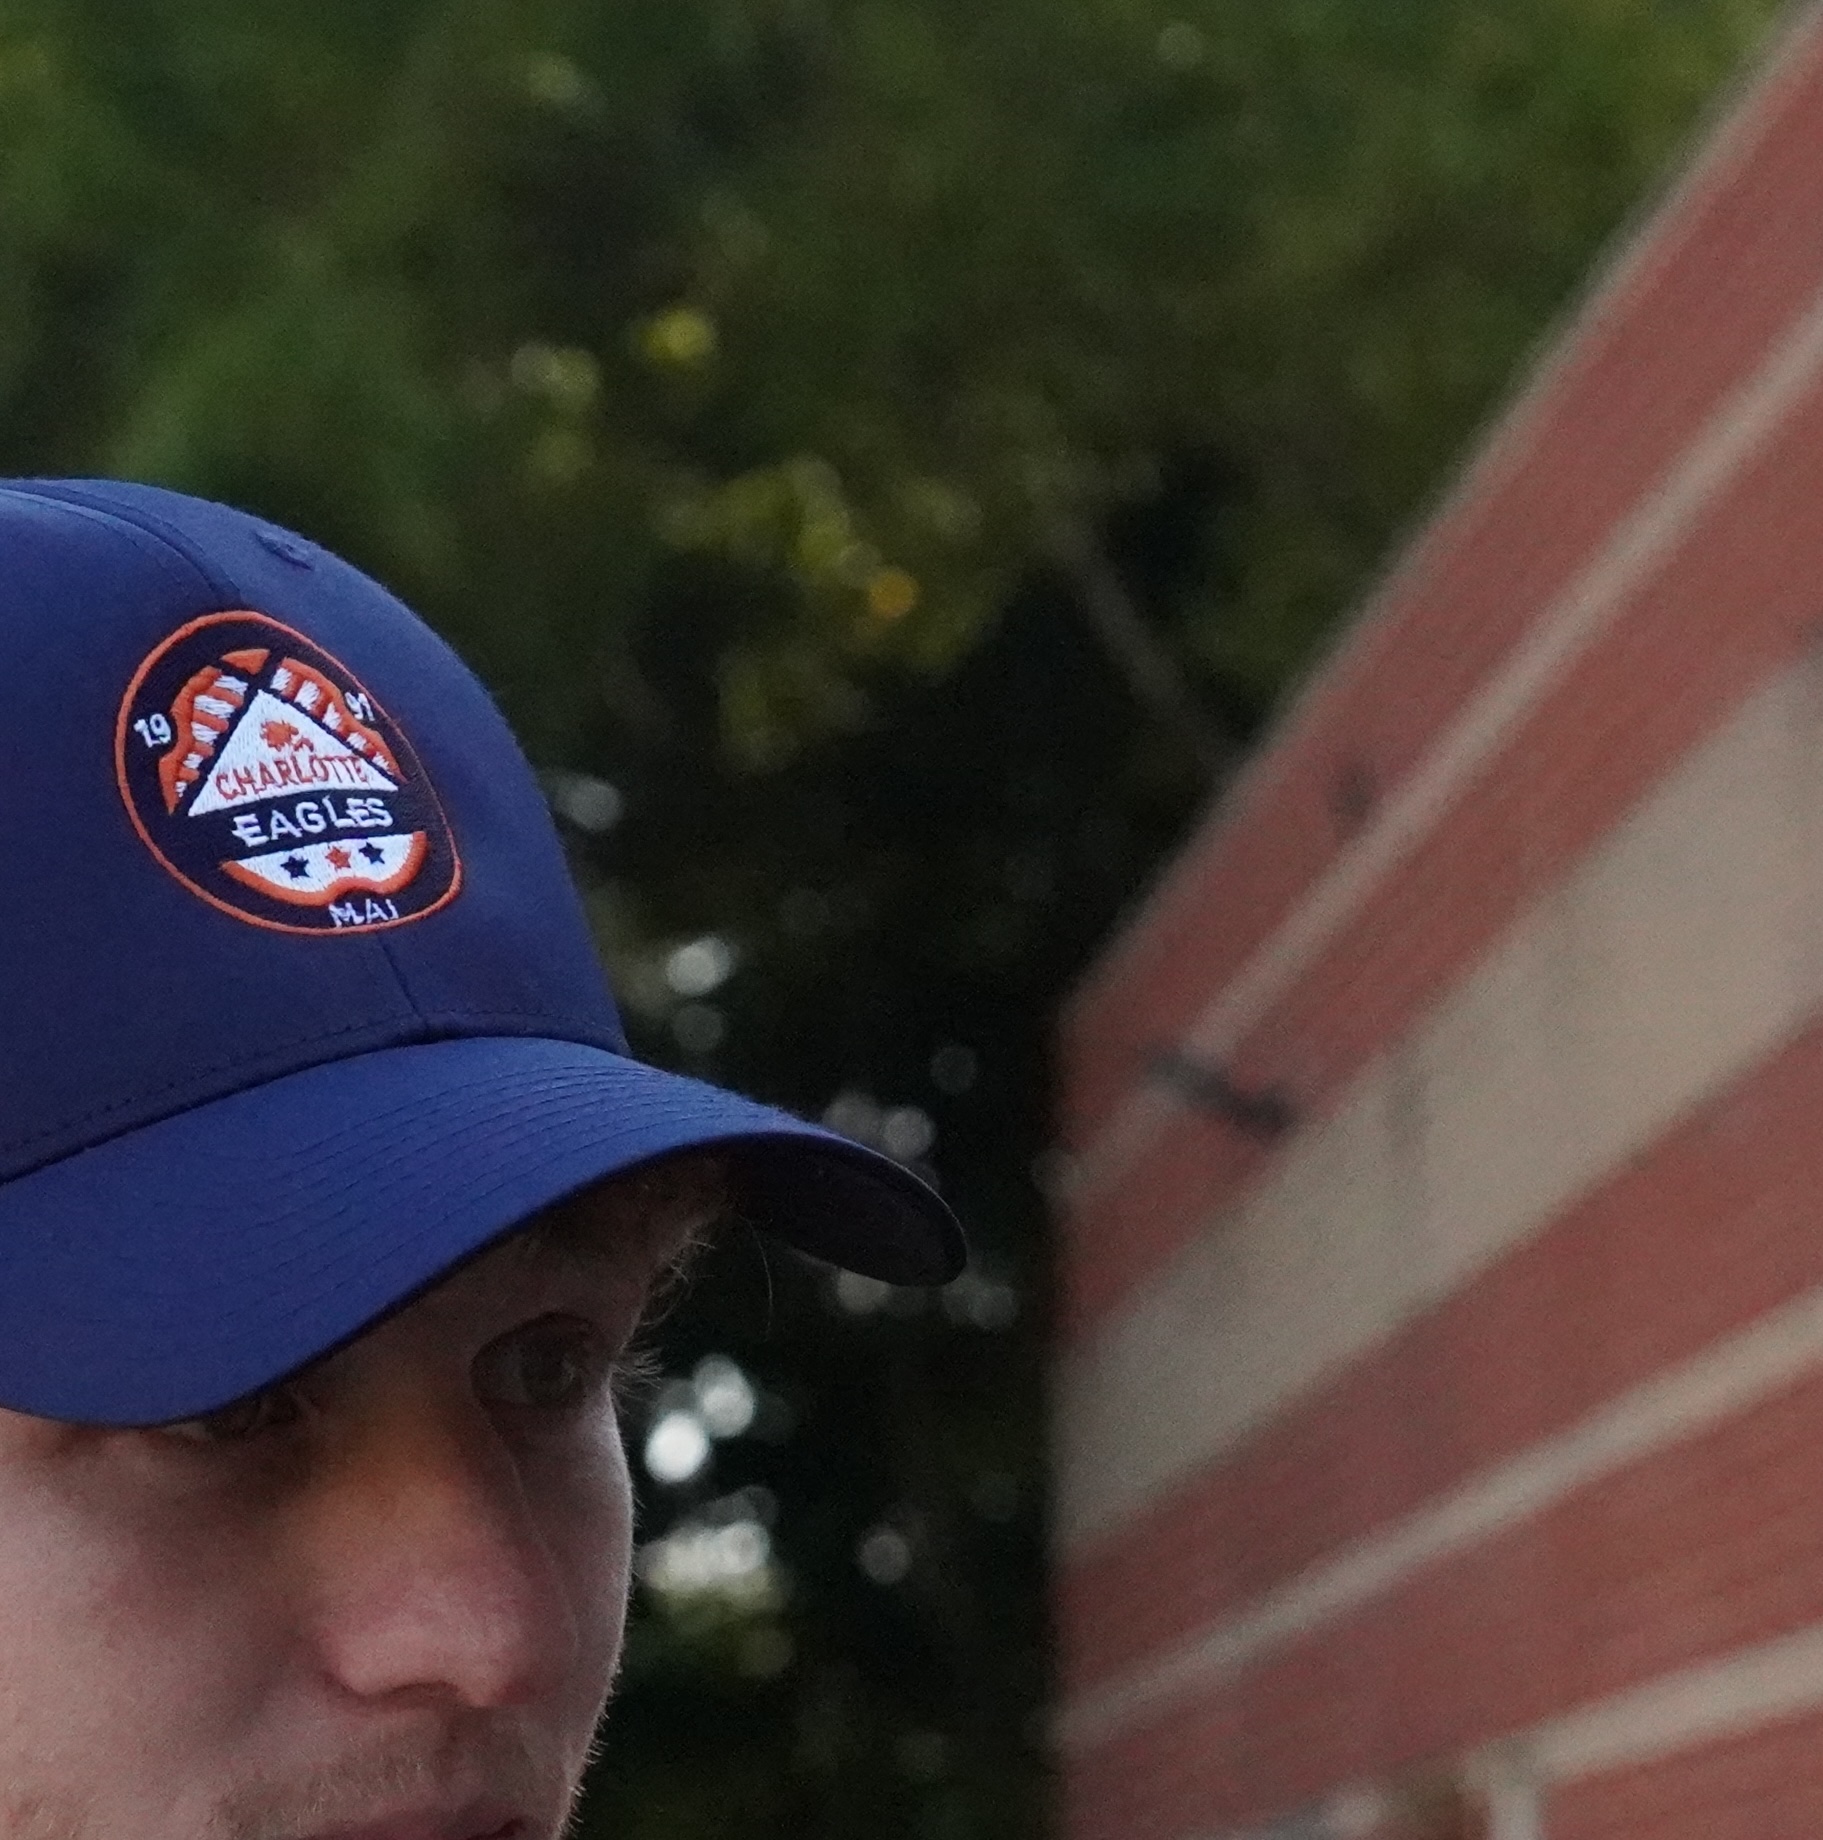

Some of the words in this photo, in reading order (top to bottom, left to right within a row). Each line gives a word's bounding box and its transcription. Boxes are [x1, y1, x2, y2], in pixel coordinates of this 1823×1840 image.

[133, 712, 172, 749] 19
[214, 754, 371, 801] CHARLOTTE
[231, 795, 394, 848] EAGLES
[327, 898, 400, 928] MAI
